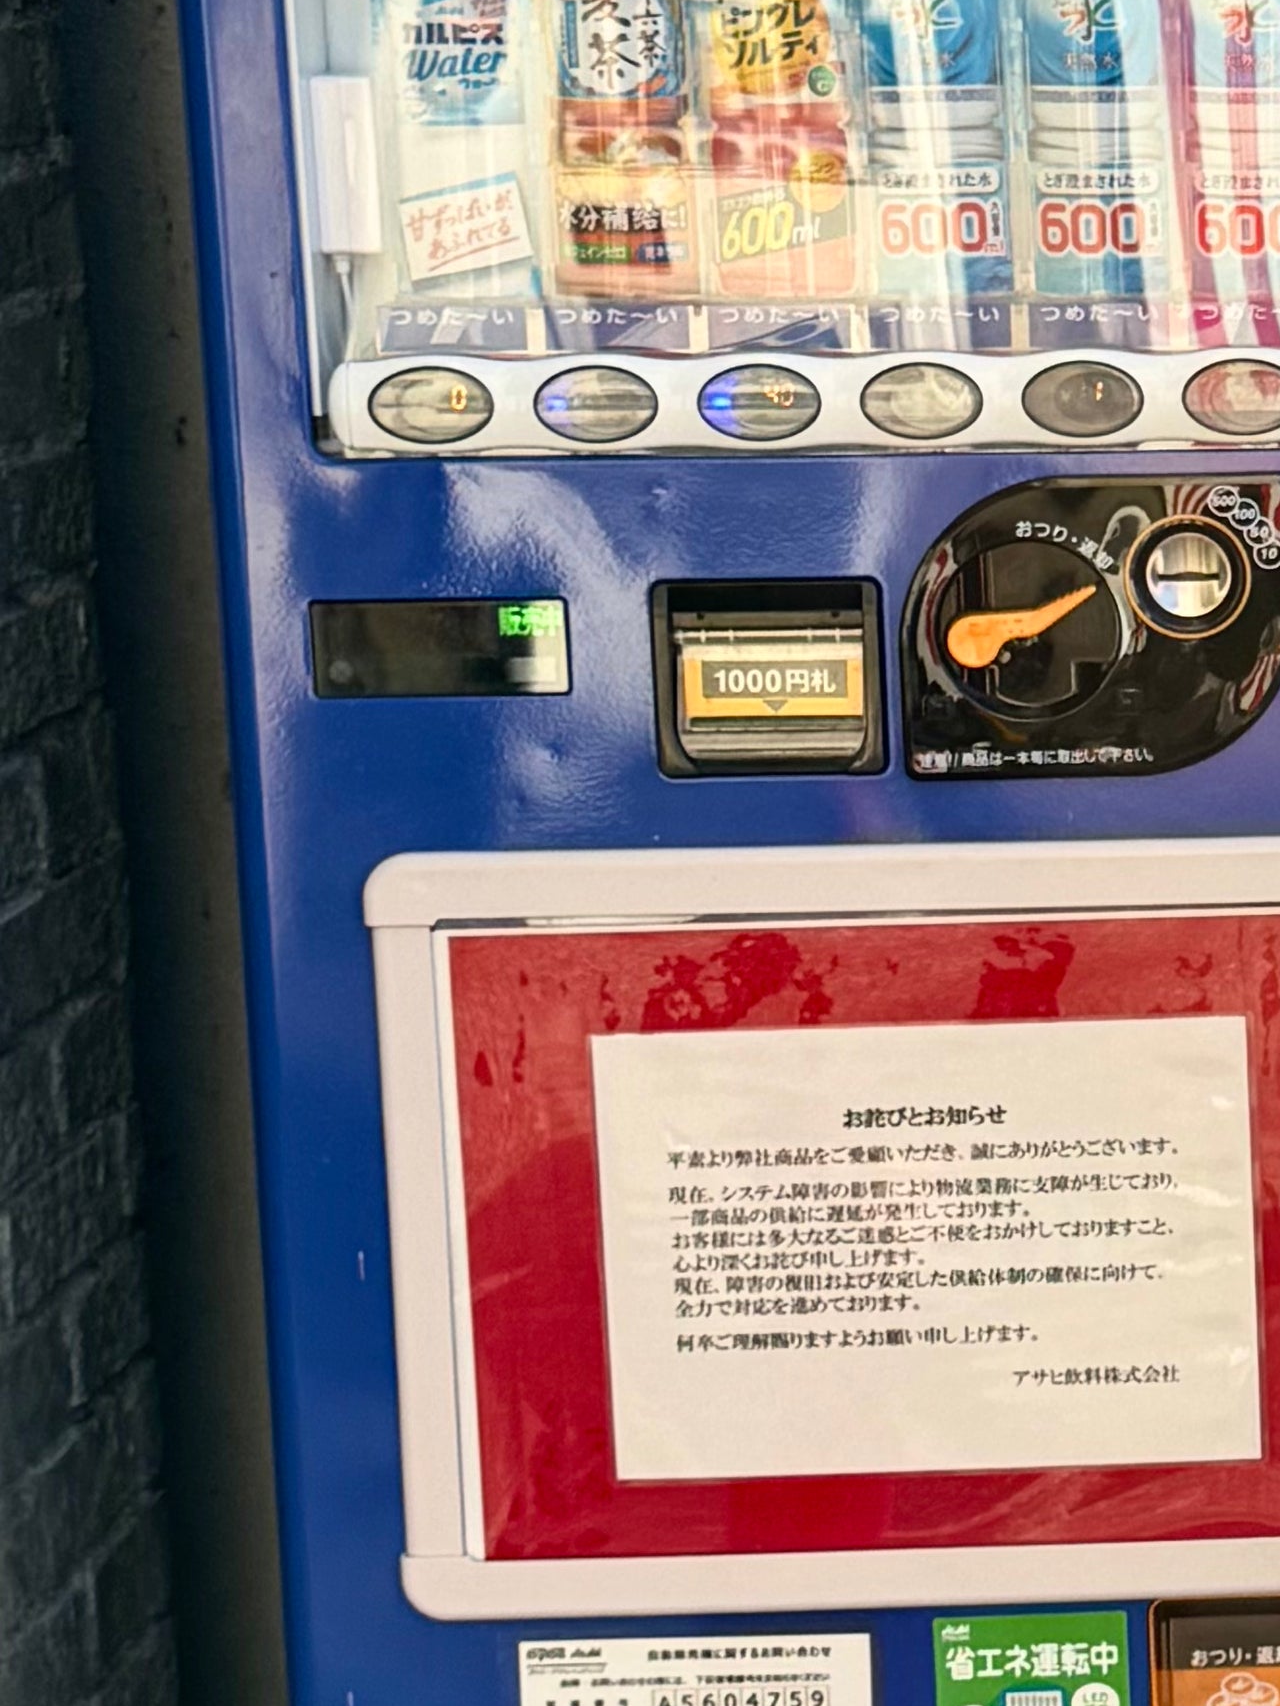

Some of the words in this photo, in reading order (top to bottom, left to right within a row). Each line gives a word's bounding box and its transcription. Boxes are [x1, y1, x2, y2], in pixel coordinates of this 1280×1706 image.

[406, 47, 508, 79] Water
[881, 200, 988, 254] 600
[1040, 200, 1144, 254] 600
[713, 668, 837, 695] 1000円札
[843, 1105, 1007, 1128] お詫びとお知らせ
[1013, 1365, 1180, 1387] アサヒ飲料株式会社
[945, 1641, 1119, 1681] 省エネ運転中
